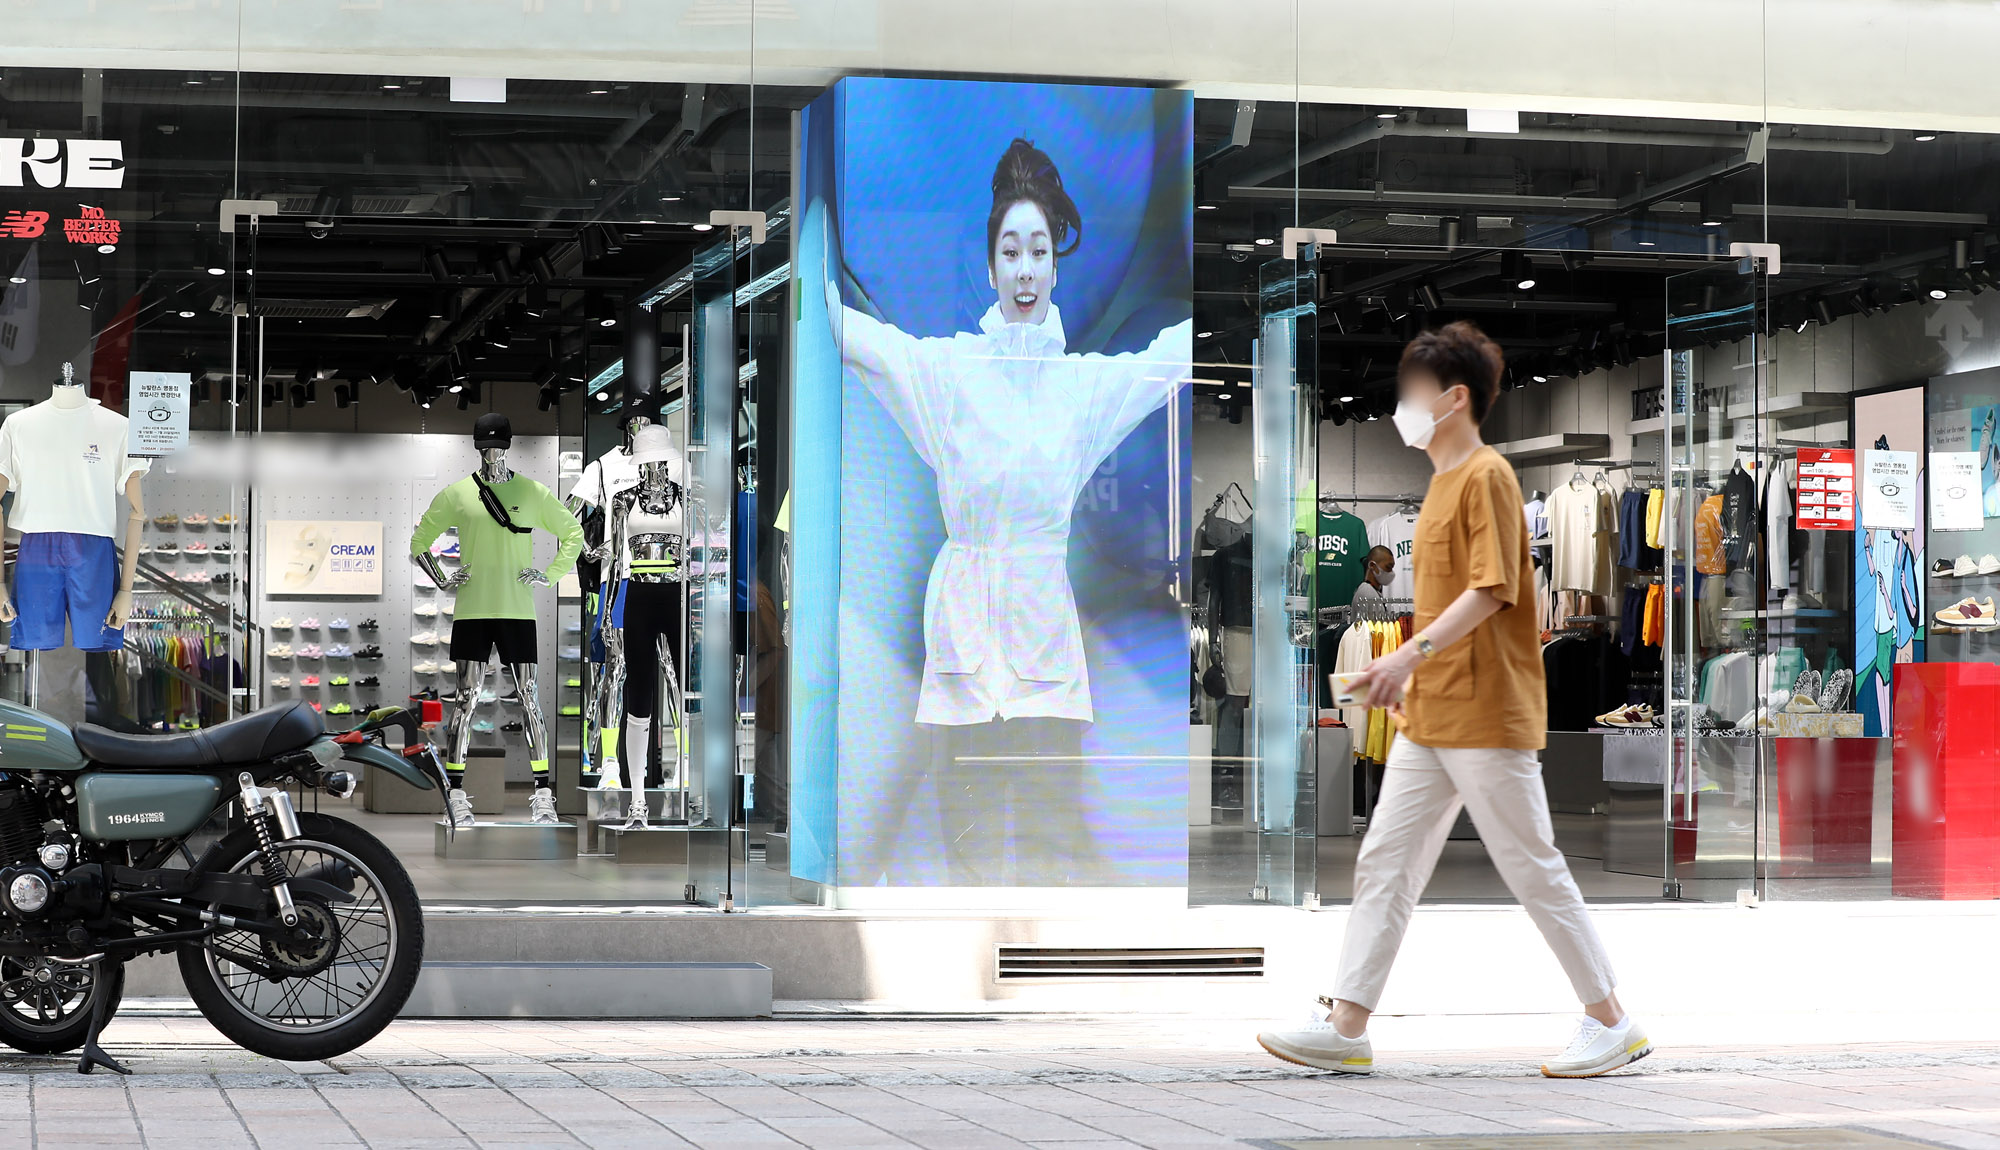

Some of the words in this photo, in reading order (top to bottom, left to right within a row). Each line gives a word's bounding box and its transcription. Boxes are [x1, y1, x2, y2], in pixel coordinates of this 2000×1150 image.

[63, 218, 121, 232] BETTER
[65, 231, 119, 245] WORKS
[330, 544, 375, 556] CREAM
[108, 813, 140, 825] 1964
